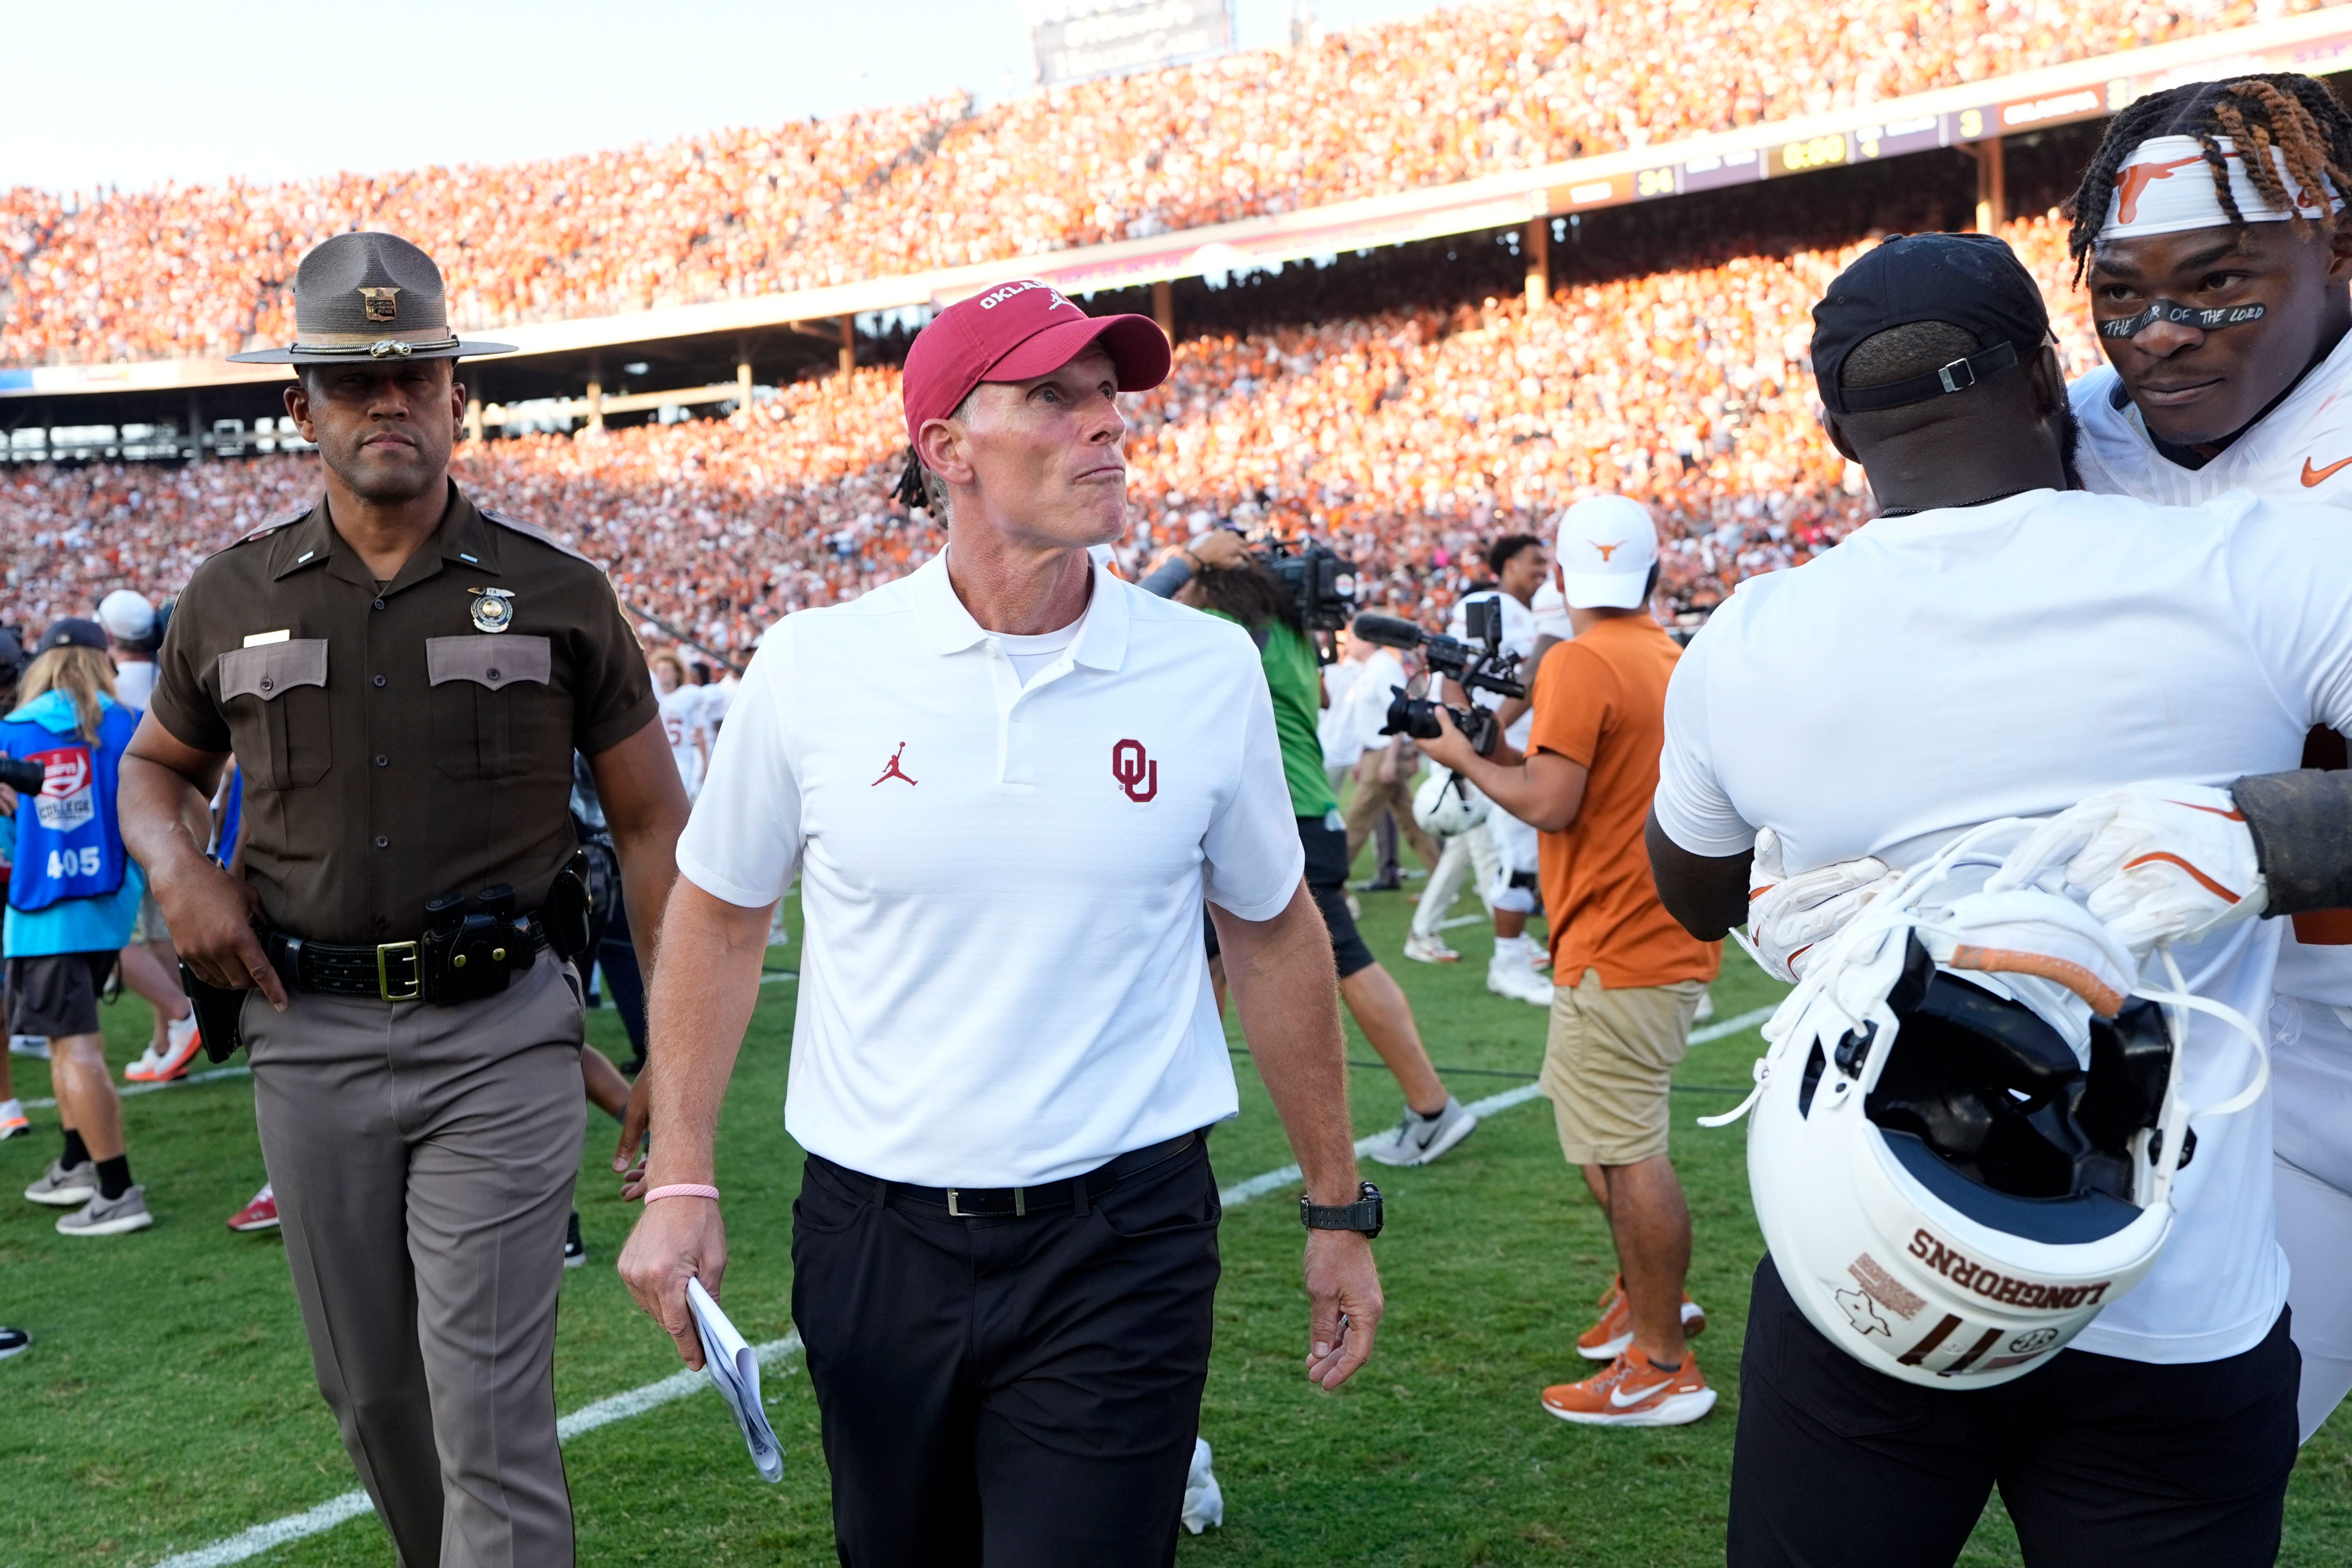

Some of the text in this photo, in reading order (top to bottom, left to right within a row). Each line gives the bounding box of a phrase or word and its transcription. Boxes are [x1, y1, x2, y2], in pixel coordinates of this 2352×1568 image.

[2104, 317, 2136, 336] THE
[2170, 308, 2193, 321] OF
[2199, 308, 2226, 324] THE
[2229, 306, 2264, 322] LORD
[1113, 738, 1157, 802] OU
[47, 846, 100, 879] 405
[1907, 1228, 2111, 1309] LONGHORNS
